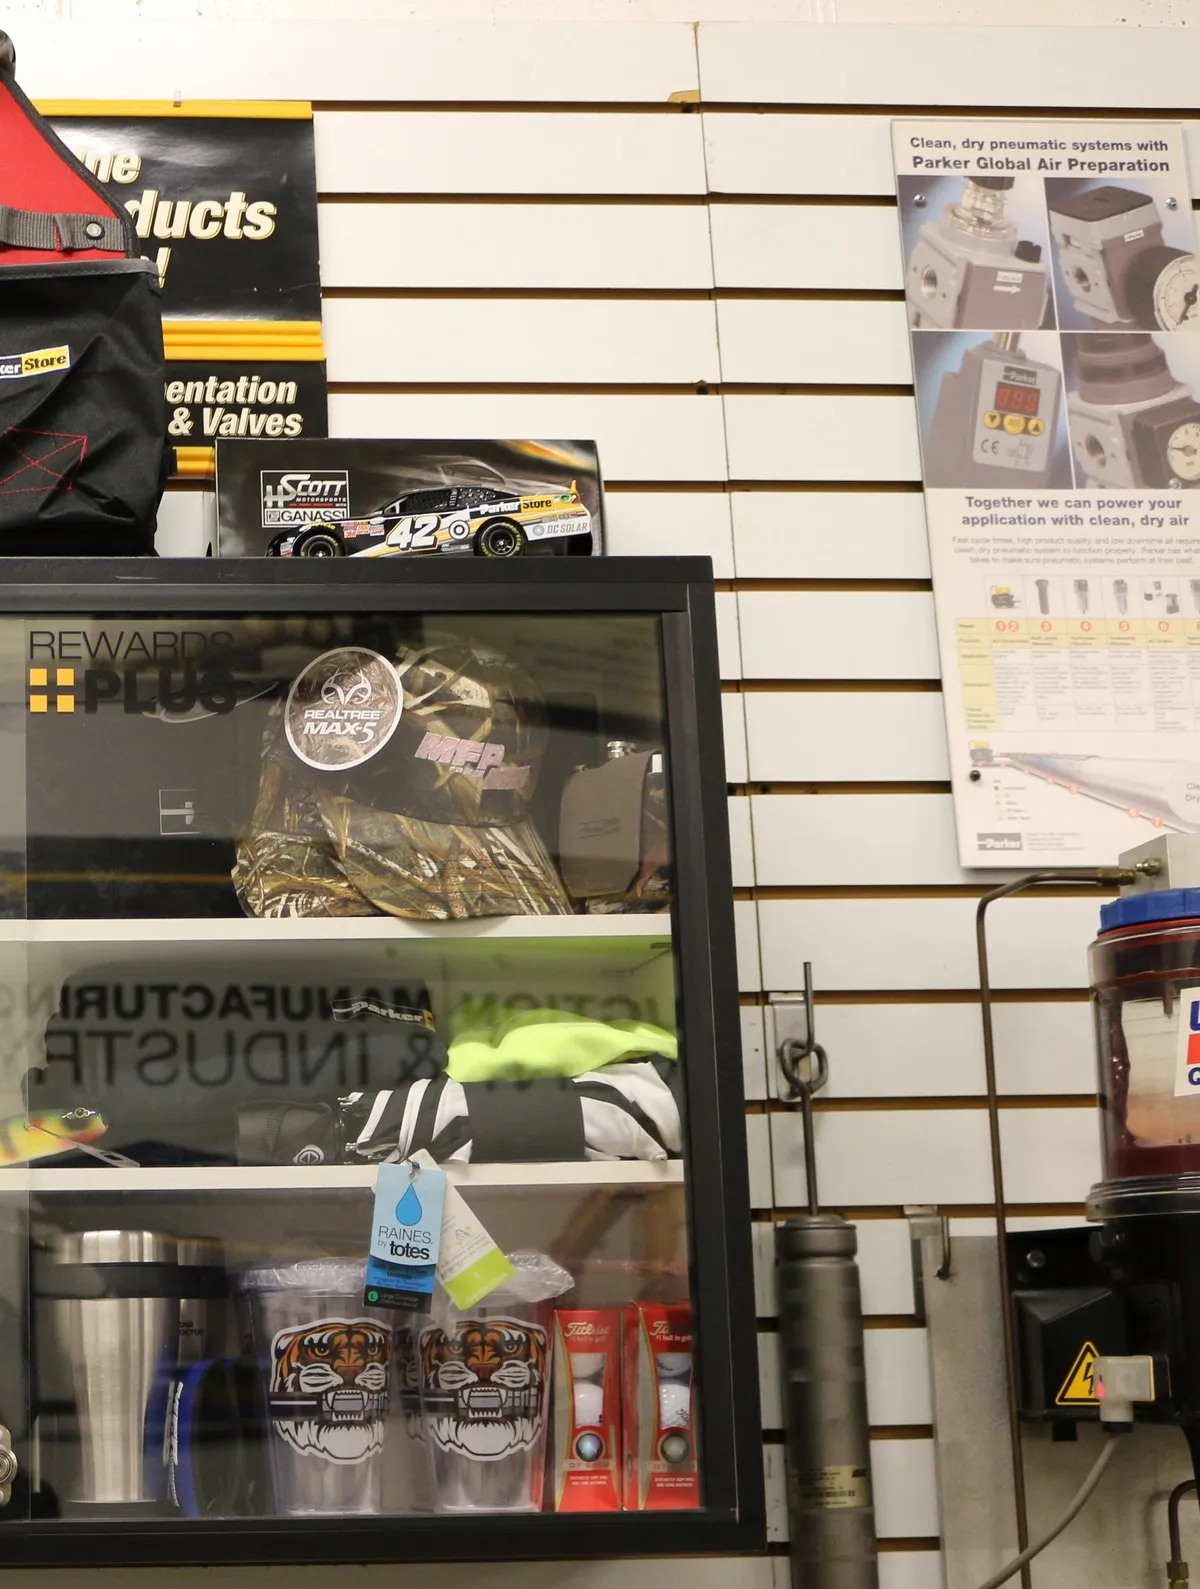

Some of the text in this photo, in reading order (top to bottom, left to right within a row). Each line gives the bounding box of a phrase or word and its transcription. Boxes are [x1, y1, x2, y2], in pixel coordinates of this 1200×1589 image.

[910, 137, 1168, 152] Clean, dry pneumatic systems with
[80, 150, 141, 184] ne
[912, 156, 1170, 173] Parker Global Air Preparation
[24, 353, 66, 371] Store
[164, 376, 298, 404] entation
[168, 407, 303, 436] & Valves
[523, 498, 552, 510] Store
[965, 496, 1182, 511] Together we can power your
[281, 510, 345, 522] GANASSI
[962, 514, 1189, 528] application with clean, dry air
[385, 515, 440, 549] 42
[547, 522, 588, 534] DC SOLAR
[29, 631, 234, 660] REWARDS
[84, 670, 237, 715] PLUS
[304, 709, 380, 720] REALTREE
[303, 721, 377, 744] MAX-5
[986, 838, 1021, 849] Parker
[352, 1001, 423, 1022] Parker
[377, 1238, 388, 1248] by
